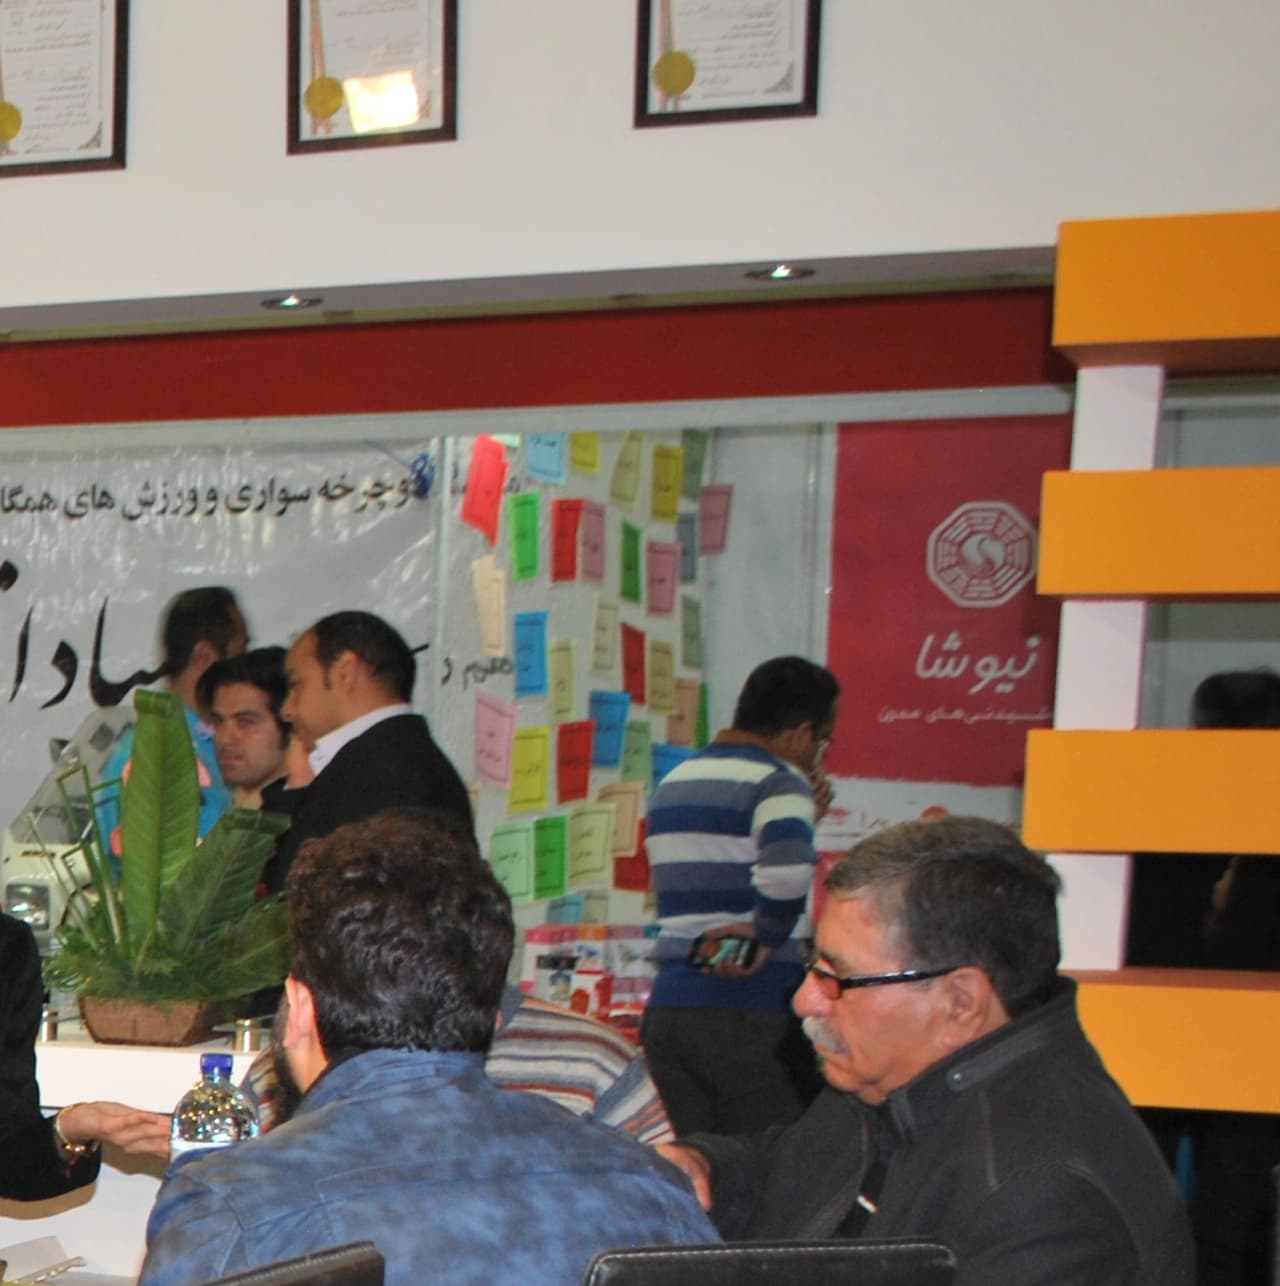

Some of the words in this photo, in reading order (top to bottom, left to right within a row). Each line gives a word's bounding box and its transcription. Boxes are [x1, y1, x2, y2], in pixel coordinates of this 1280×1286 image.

[64, 484, 115, 519] های
[122, 480, 198, 521] ورزش
[225, 477, 311, 517] سواری
[915, 630, 1040, 695] نیوشا
